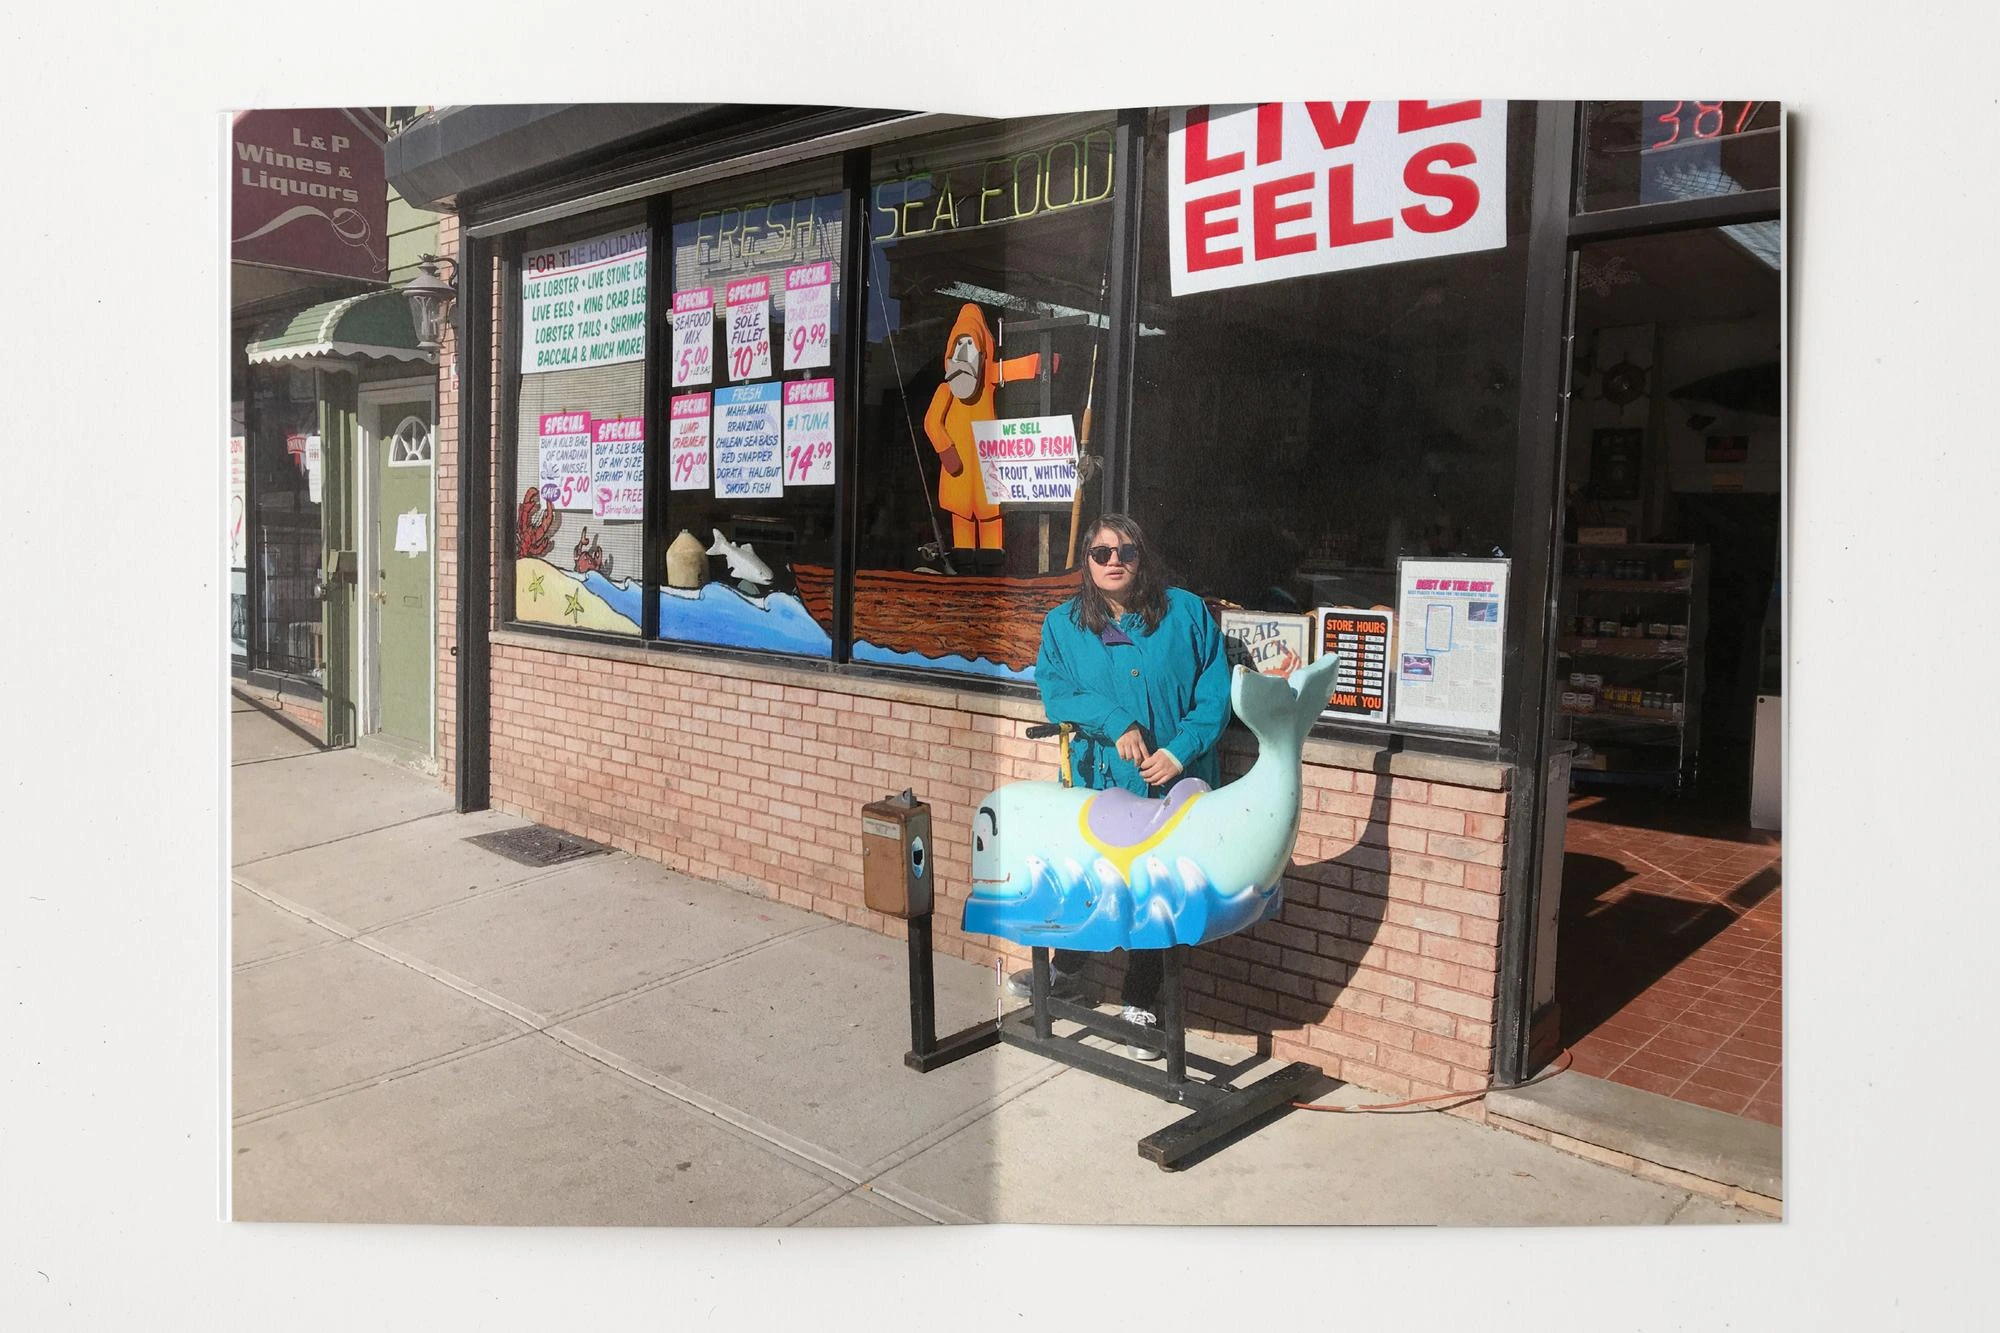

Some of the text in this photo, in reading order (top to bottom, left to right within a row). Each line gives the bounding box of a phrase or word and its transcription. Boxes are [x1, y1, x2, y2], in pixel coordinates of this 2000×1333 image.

[236, 142, 352, 179] Wines &
[242, 167, 359, 203] Liquors
[1185, 142, 1480, 273] EELS
[696, 197, 816, 265] FRESH
[528, 254, 555, 274] FOR
[558, 247, 587, 269] THE
[523, 280, 541, 299] LIVE
[544, 276, 578, 297] LOBSTER
[588, 270, 603, 290] LIVE
[606, 265, 630, 286] STONE
[788, 264, 828, 288] SPECIAL
[728, 280, 766, 302] SPECIAL
[532, 301, 550, 322] LIVE
[554, 300, 574, 318] EELS
[583, 294, 602, 314] KING
[606, 290, 629, 310] CRAB
[676, 290, 709, 312] SPECIAL
[736, 303, 759, 314] FRESH
[674, 311, 711, 332] SEAFOOD
[734, 312, 760, 330] SOLE
[536, 324, 574, 344] LOBSTER
[578, 320, 601, 339] TAILS
[683, 329, 702, 344] MIX
[731, 328, 765, 345] FILLET
[538, 336, 645, 366] BACCALA & MUCH MORE!
[732, 386, 763, 400] FRESH
[788, 382, 830, 402] SPECIAL
[673, 398, 708, 416] SPECIAL
[726, 404, 768, 416] MAHI-MAHI
[544, 415, 584, 434] SPECIAL
[680, 422, 700, 435] LUMP
[728, 420, 766, 432] BRANZINO
[787, 412, 830, 431] #1 TUNA
[1002, 422, 1042, 436] WE SELL
[598, 422, 642, 441] SPECIAL
[541, 438, 552, 448] BUY
[552, 438, 558, 448] A
[574, 436, 588, 446] BAG
[596, 444, 608, 455] BUY
[608, 444, 614, 454] A
[615, 443, 628, 454] 5LB
[672, 436, 707, 450] CRABMEAT
[716, 436, 742, 448] CHILEAN
[758, 435, 778, 446] BASS
[978, 436, 1074, 458] SMOKED FISH
[546, 450, 588, 461] OF CANADIAN
[599, 456, 642, 468] OF ANY SIZE
[721, 451, 772, 464] RED SNAPPER
[561, 462, 588, 473] MUSSEL
[716, 466, 780, 480] DORATA HALIBUT
[998, 464, 1076, 482] TROUT, WHITING
[595, 472, 624, 482] SHRIMP
[542, 486, 558, 499] SAVE
[614, 488, 643, 502] A FREE
[726, 482, 772, 494] SWORD FISH
[1011, 484, 1072, 500] EEL, SALMON
[1226, 622, 1280, 648] CRAB
[1326, 620, 1386, 634] STORE HOURS
[1330, 693, 1382, 708] HANK YOU
